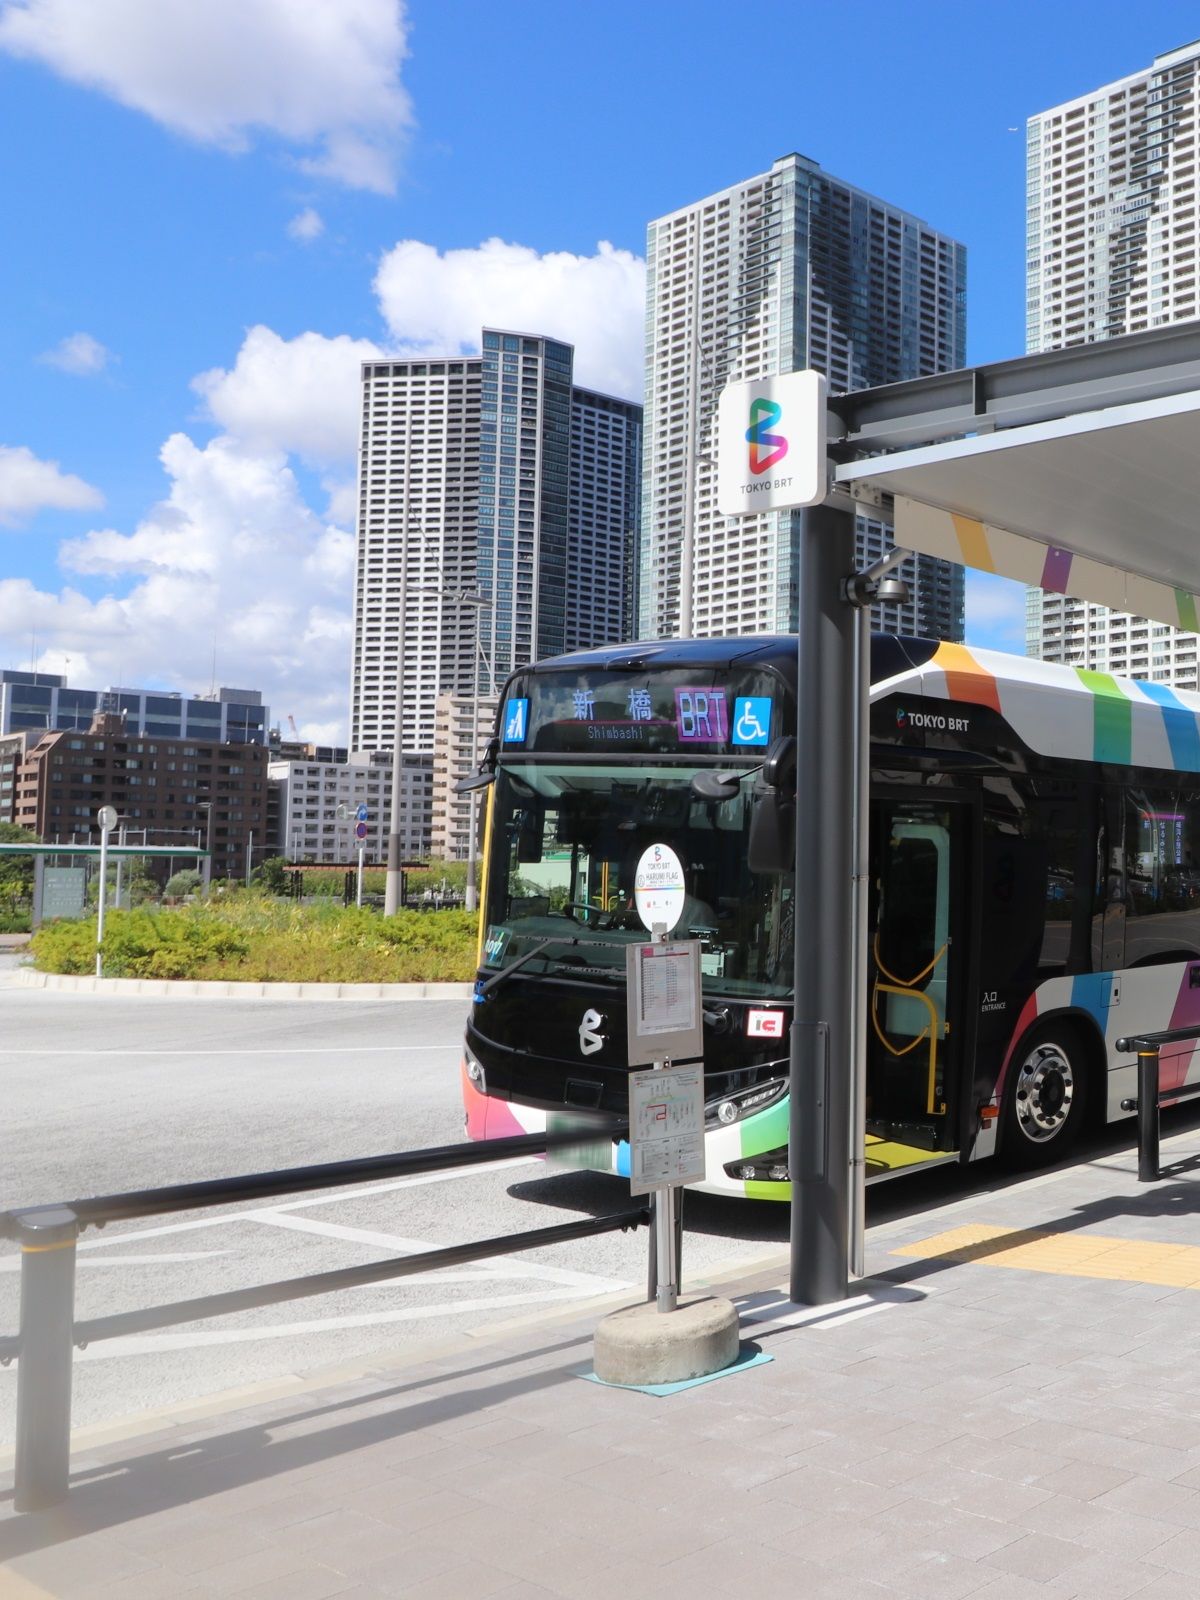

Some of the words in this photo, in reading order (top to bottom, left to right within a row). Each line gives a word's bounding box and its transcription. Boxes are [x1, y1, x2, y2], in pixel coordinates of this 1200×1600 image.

[740, 481, 771, 494] TOKYO
[774, 478, 793, 488] BRT
[679, 692, 724, 737] BRT
[908, 712, 946, 729] TOKYO
[948, 718, 969, 732] BRT
[588, 726, 643, 740] Shimbashi
[982, 991, 998, 1004] 入口
[981, 1002, 1006, 1012] ENTRANCE
